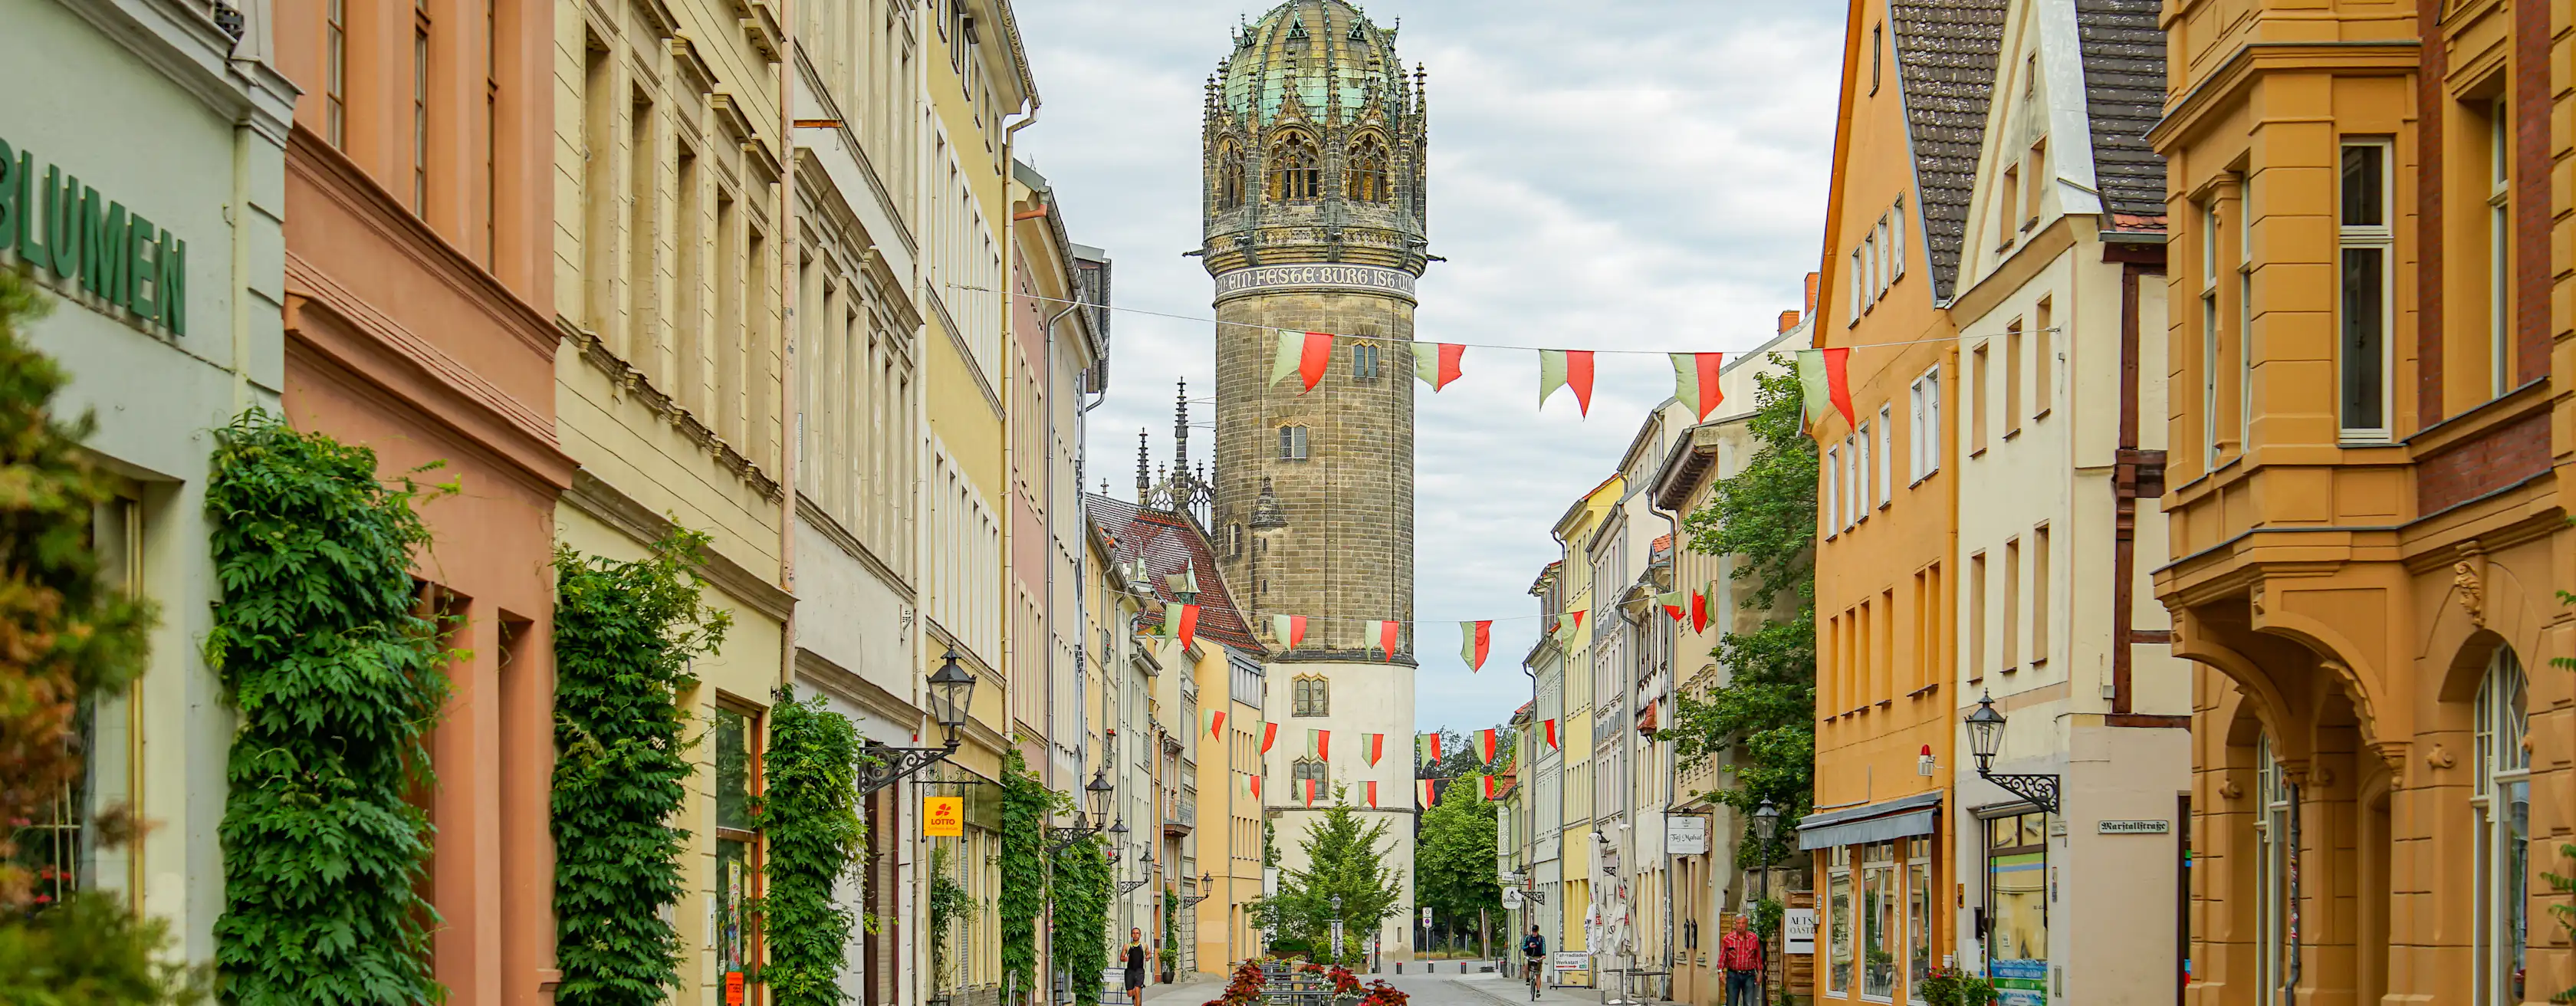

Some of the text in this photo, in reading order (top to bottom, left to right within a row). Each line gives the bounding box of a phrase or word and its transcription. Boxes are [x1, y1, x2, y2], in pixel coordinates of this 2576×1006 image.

[0, 137, 186, 337] BLUMEN
[1229, 271, 1251, 290] EIN
[1256, 267, 1316, 286] FESTE
[1319, 267, 1368, 284] BURG
[1373, 270, 1396, 288] IST
[1669, 833, 1703, 843] Taj Mahal
